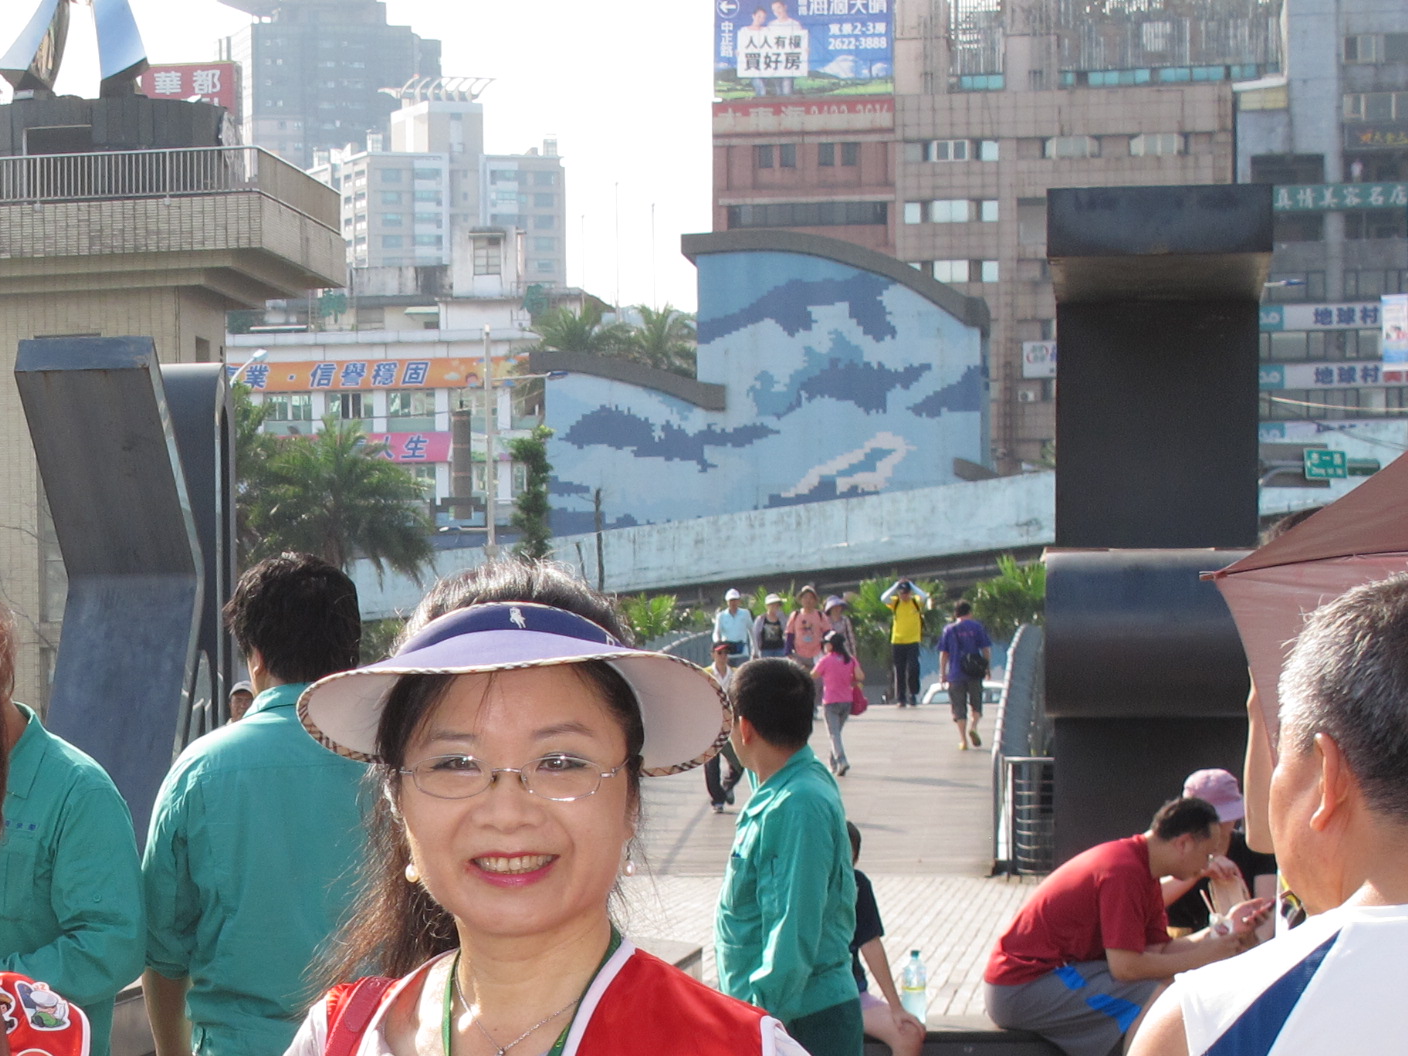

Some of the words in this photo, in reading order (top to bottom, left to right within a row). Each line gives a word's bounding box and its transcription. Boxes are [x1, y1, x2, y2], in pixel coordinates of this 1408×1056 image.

[745, 35, 802, 50] 人人有權
[744, 52, 802, 71] 買好房
[153, 69, 221, 95] 華都
[1314, 306, 1379, 325] 地球村
[1314, 365, 1379, 385] 地球村
